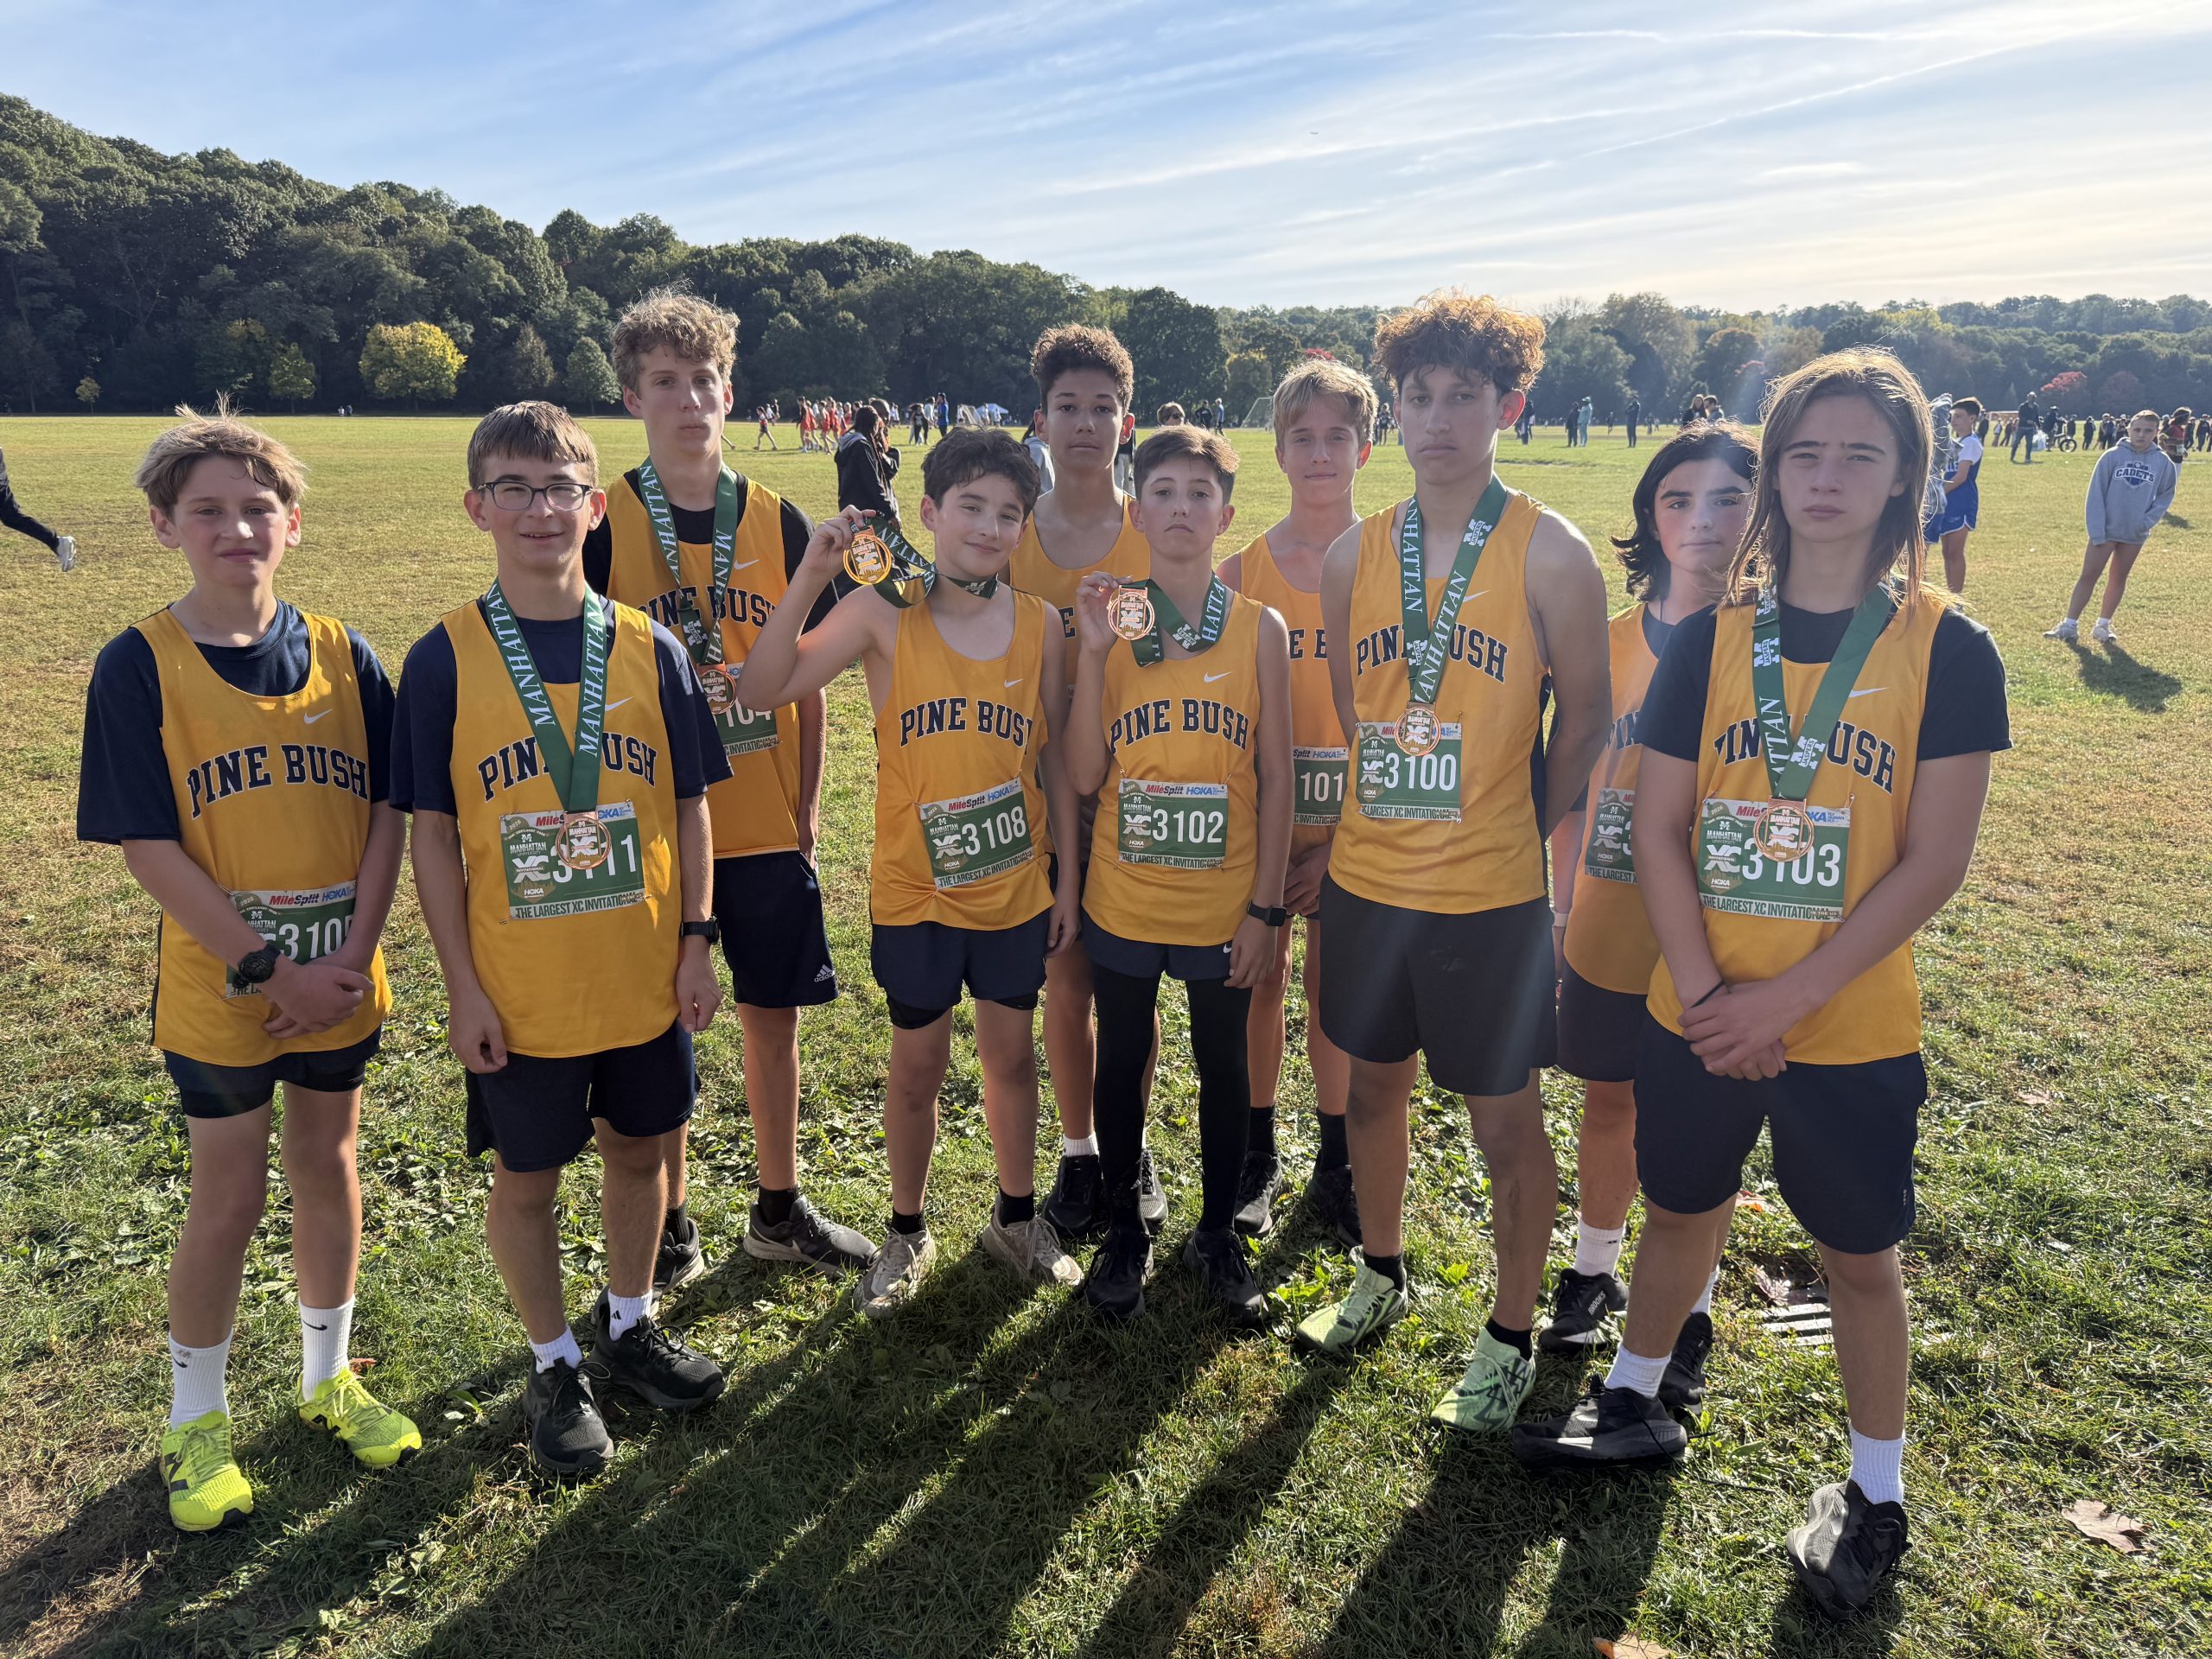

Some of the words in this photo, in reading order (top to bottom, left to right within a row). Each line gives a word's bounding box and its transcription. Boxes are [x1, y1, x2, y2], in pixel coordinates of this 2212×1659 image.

[2115, 467, 2155, 482] CADETS
[639, 465, 681, 588] ANHATTAN
[1402, 498, 1423, 613] ANHATTAN
[640, 586, 702, 630] INE
[486, 583, 557, 727] MANHATTAN
[1447, 622, 1509, 684] USH
[579, 603, 605, 759] MANHATTAN
[900, 696, 967, 747] PINE
[1109, 698, 1171, 756] PINE
[1181, 698, 1249, 751] BUSH
[1801, 739, 1815, 765] JASPERS
[1827, 720, 1897, 795] USH
[477, 735, 550, 804] PIN
[601, 731, 658, 789] USH
[1360, 760, 1384, 784] XC
[1383, 752, 1457, 791] 3100
[187, 744, 273, 820] PINE
[280, 743, 369, 802] BUSH
[988, 786, 1010, 802] HOKA
[1145, 785, 1184, 796] MileSplit
[1185, 787, 1213, 796] HOKA
[1300, 772, 1344, 802] 101
[597, 808, 620, 820] OKA
[948, 795, 986, 812] MileSplit
[1123, 803, 1152, 812] MANHATTAN
[1367, 805, 1394, 817] LARGEST
[1394, 806, 1404, 817] XC
[1122, 814, 1152, 836] XC
[1152, 809, 1224, 843] 3102
[1807, 810, 1827, 823] KA
[929, 823, 959, 836] MANHATTAN
[962, 805, 1027, 856] 3108
[1592, 823, 1624, 849] XC
[1706, 830, 1742, 843] MANHATTAN
[510, 842, 547, 855] MANHATTAN
[931, 834, 965, 860] XC
[1122, 853, 1134, 863] THE
[1134, 853, 1163, 865] LARGEST
[1163, 856, 1173, 866] XC
[1704, 844, 1742, 874] XC
[512, 855, 551, 884] XC
[938, 876, 953, 888] THE
[953, 869, 982, 886] LARGEST
[982, 867, 992, 878] XC
[1589, 866, 1602, 879] THE
[1602, 868, 1631, 882] LARGEST
[321, 888, 346, 902] HOKA
[1711, 878, 1731, 887] HOKA
[269, 893, 320, 906] MileSplit
[515, 906, 533, 919] THE
[534, 902, 571, 918] LARGEST
[572, 900, 584, 913] XC
[584, 893, 638, 911] INVITATIONAL
[1702, 894, 1716, 908] THE
[1717, 896, 1754, 914] LARGEST
[1754, 900, 1767, 915] XC
[1767, 903, 1831, 920] INVITATIONAL
[247, 919, 276, 929] NHATTAN
[814, 969, 836, 982] adida
[1588, 1290, 1606, 1315] BROOKS
